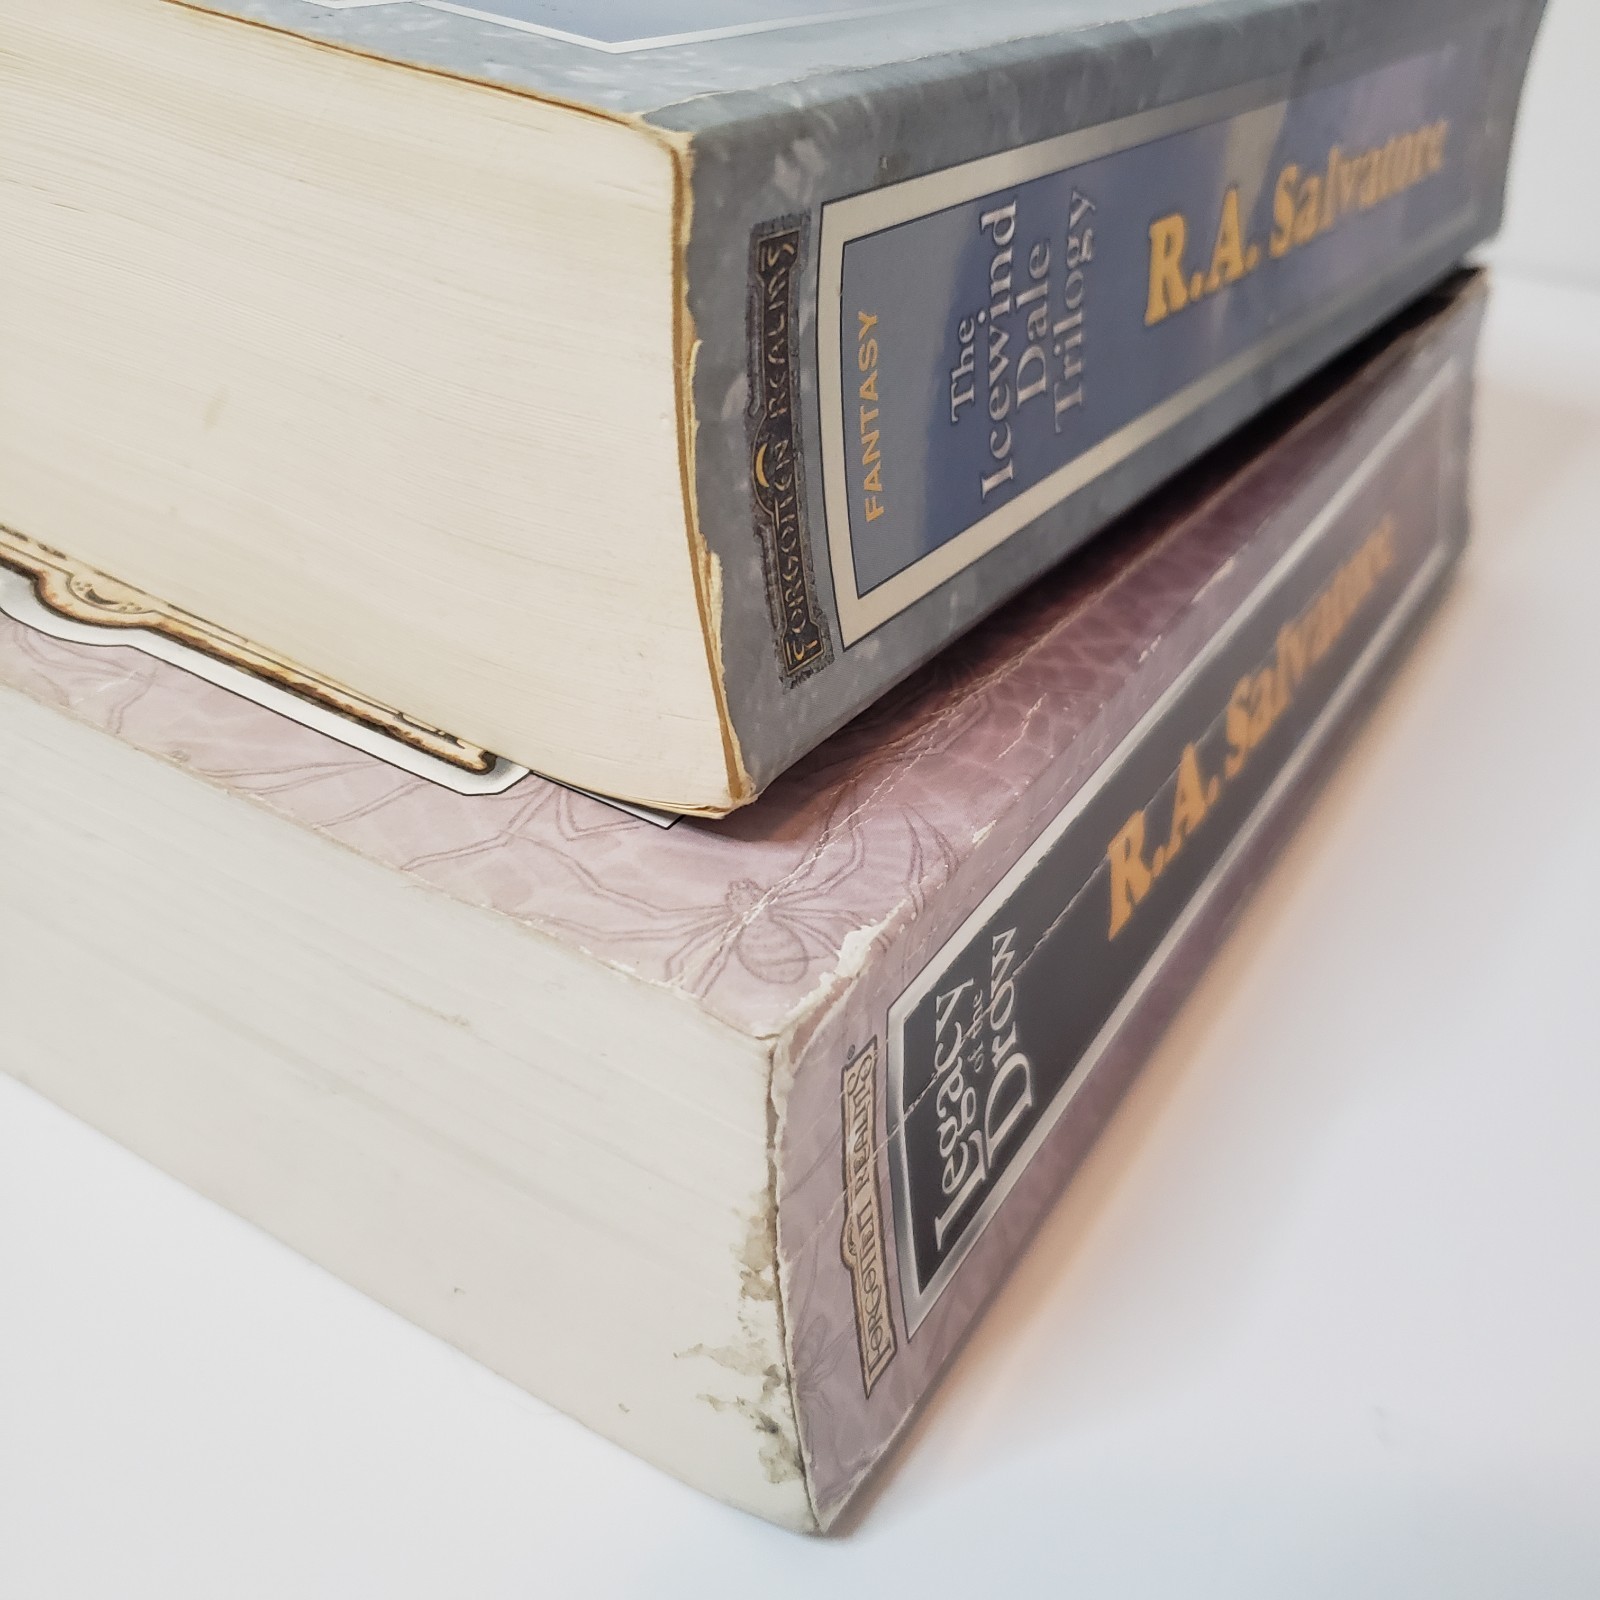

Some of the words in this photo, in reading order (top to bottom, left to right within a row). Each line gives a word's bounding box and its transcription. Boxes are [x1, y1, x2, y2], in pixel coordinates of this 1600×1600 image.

[858, 310, 884, 522] FANTASY
[951, 317, 975, 424] The
[977, 197, 1017, 500] Icewind
[1016, 241, 1051, 412] Dale
[1053, 188, 1096, 434] Trilogy
[936, 979, 986, 1251] Legacy
[969, 989, 984, 1037] the
[969, 1038, 985, 1073] of
[985, 927, 1032, 1165] Drow
